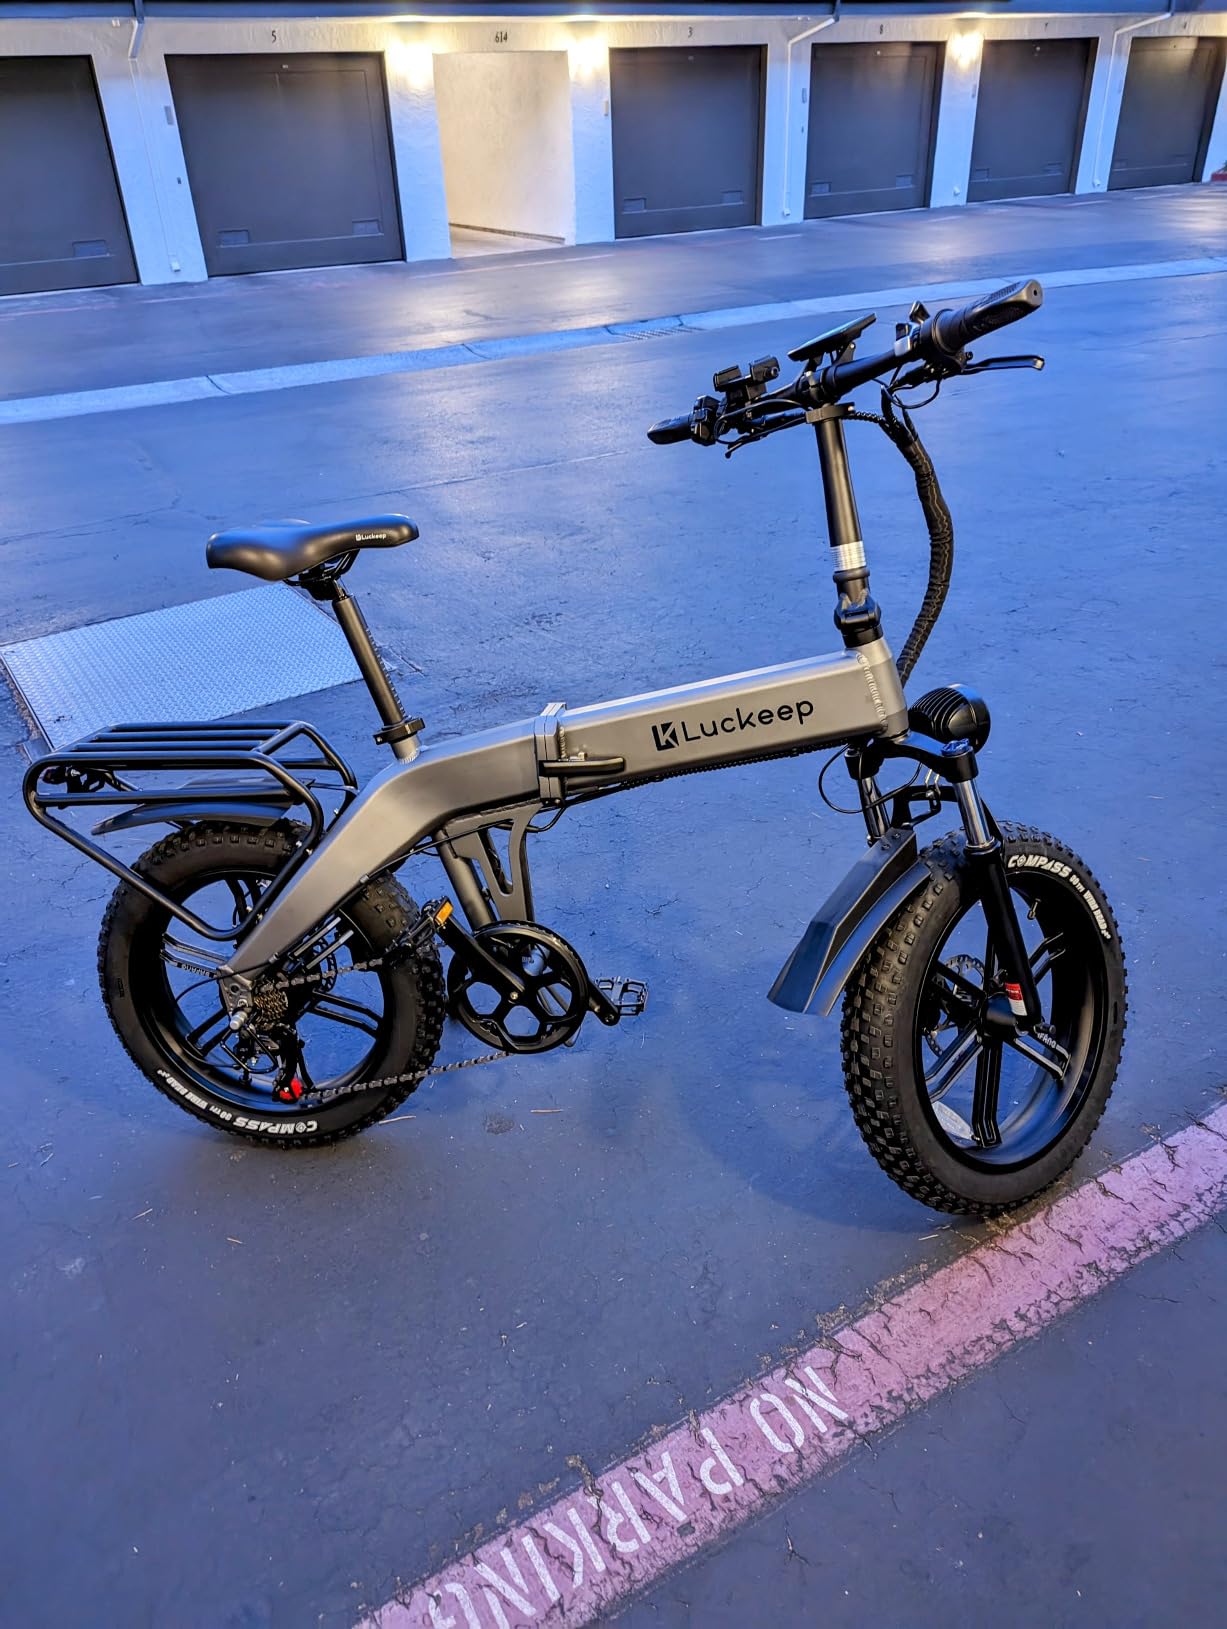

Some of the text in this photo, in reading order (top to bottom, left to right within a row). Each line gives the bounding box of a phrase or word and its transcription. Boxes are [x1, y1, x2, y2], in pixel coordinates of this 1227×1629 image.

[271, 29, 277, 44] 5
[494, 31, 508, 43] 614
[681, 700, 814, 742] Luckeep
[1007, 854, 1073, 878] COMPASS
[233, 1116, 318, 1135] COMPASS
[428, 1366, 848, 1629] NO PARKING
